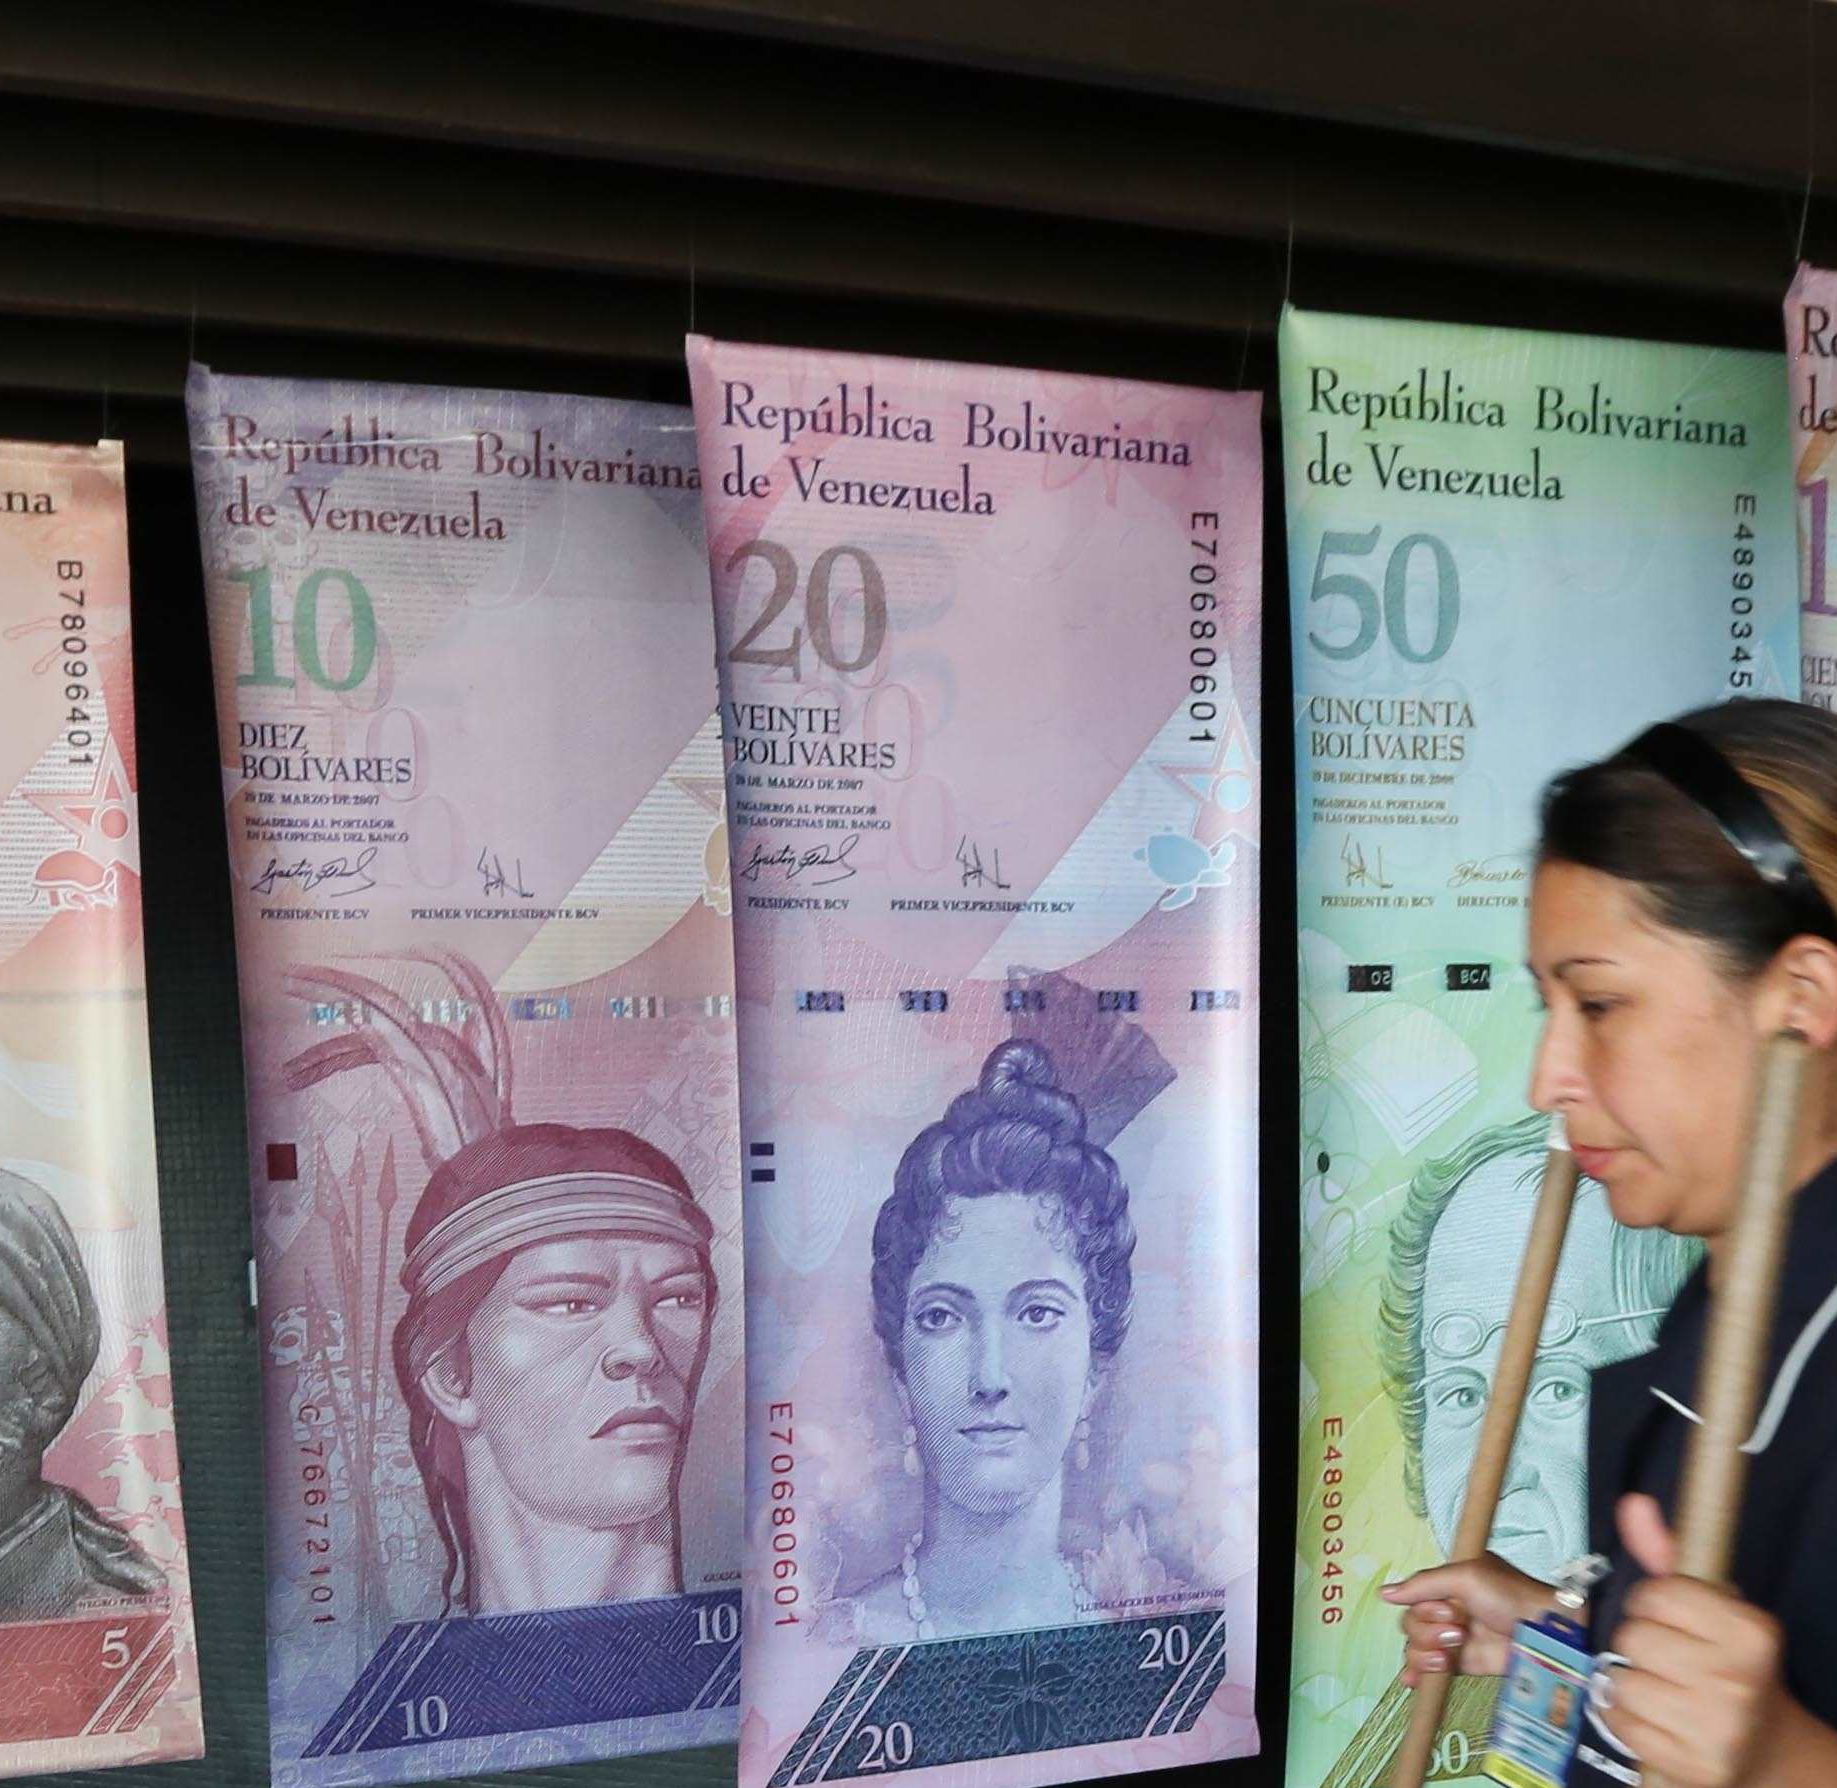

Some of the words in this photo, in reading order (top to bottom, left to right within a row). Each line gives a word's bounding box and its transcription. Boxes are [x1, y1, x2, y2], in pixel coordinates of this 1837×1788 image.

[721, 380, 935, 445] República
[963, 401, 1193, 467] Bolivariana
[1308, 367, 1507, 431] República
[1535, 382, 1747, 448] Bolivariana
[225, 412, 443, 477] República
[472, 426, 702, 491] Bolivariana
[1306, 432, 1353, 488] de
[1367, 443, 1563, 500] Venezuela
[225, 477, 277, 527] de
[291, 486, 507, 541] Venezuela
[723, 446, 772, 498] de
[789, 458, 996, 517] Venezuela
[726, 539, 887, 682] 20
[1309, 523, 1461, 664] 50
[1729, 494, 1757, 700] E4890345
[230, 565, 378, 692] 10
[1188, 510, 1219, 744] E70680601
[57, 559, 94, 766] B78096401
[239, 721, 306, 750] DIEZ
[731, 703, 842, 735] VEINTE
[1310, 697, 1476, 728] CINCUENTA
[240, 752, 412, 784] BOLÍVARES
[733, 730, 896, 769] BOLÍVARES
[1311, 727, 1466, 761] BOLÍVARES
[280, 794, 330, 804] MARZO
[768, 776, 814, 789] MARZO
[411, 908, 460, 919] PRIMER
[891, 899, 939, 911] PRIMER
[299, 1405, 336, 1625] C76672101
[769, 1401, 800, 1627] E70680601
[1321, 1416, 1344, 1626] E48903456
[100, 1627, 131, 1670] 5
[691, 1603, 739, 1645] 10
[1137, 1624, 1190, 1672] 20
[400, 1696, 449, 1741] 10
[857, 1720, 914, 1770] 20
